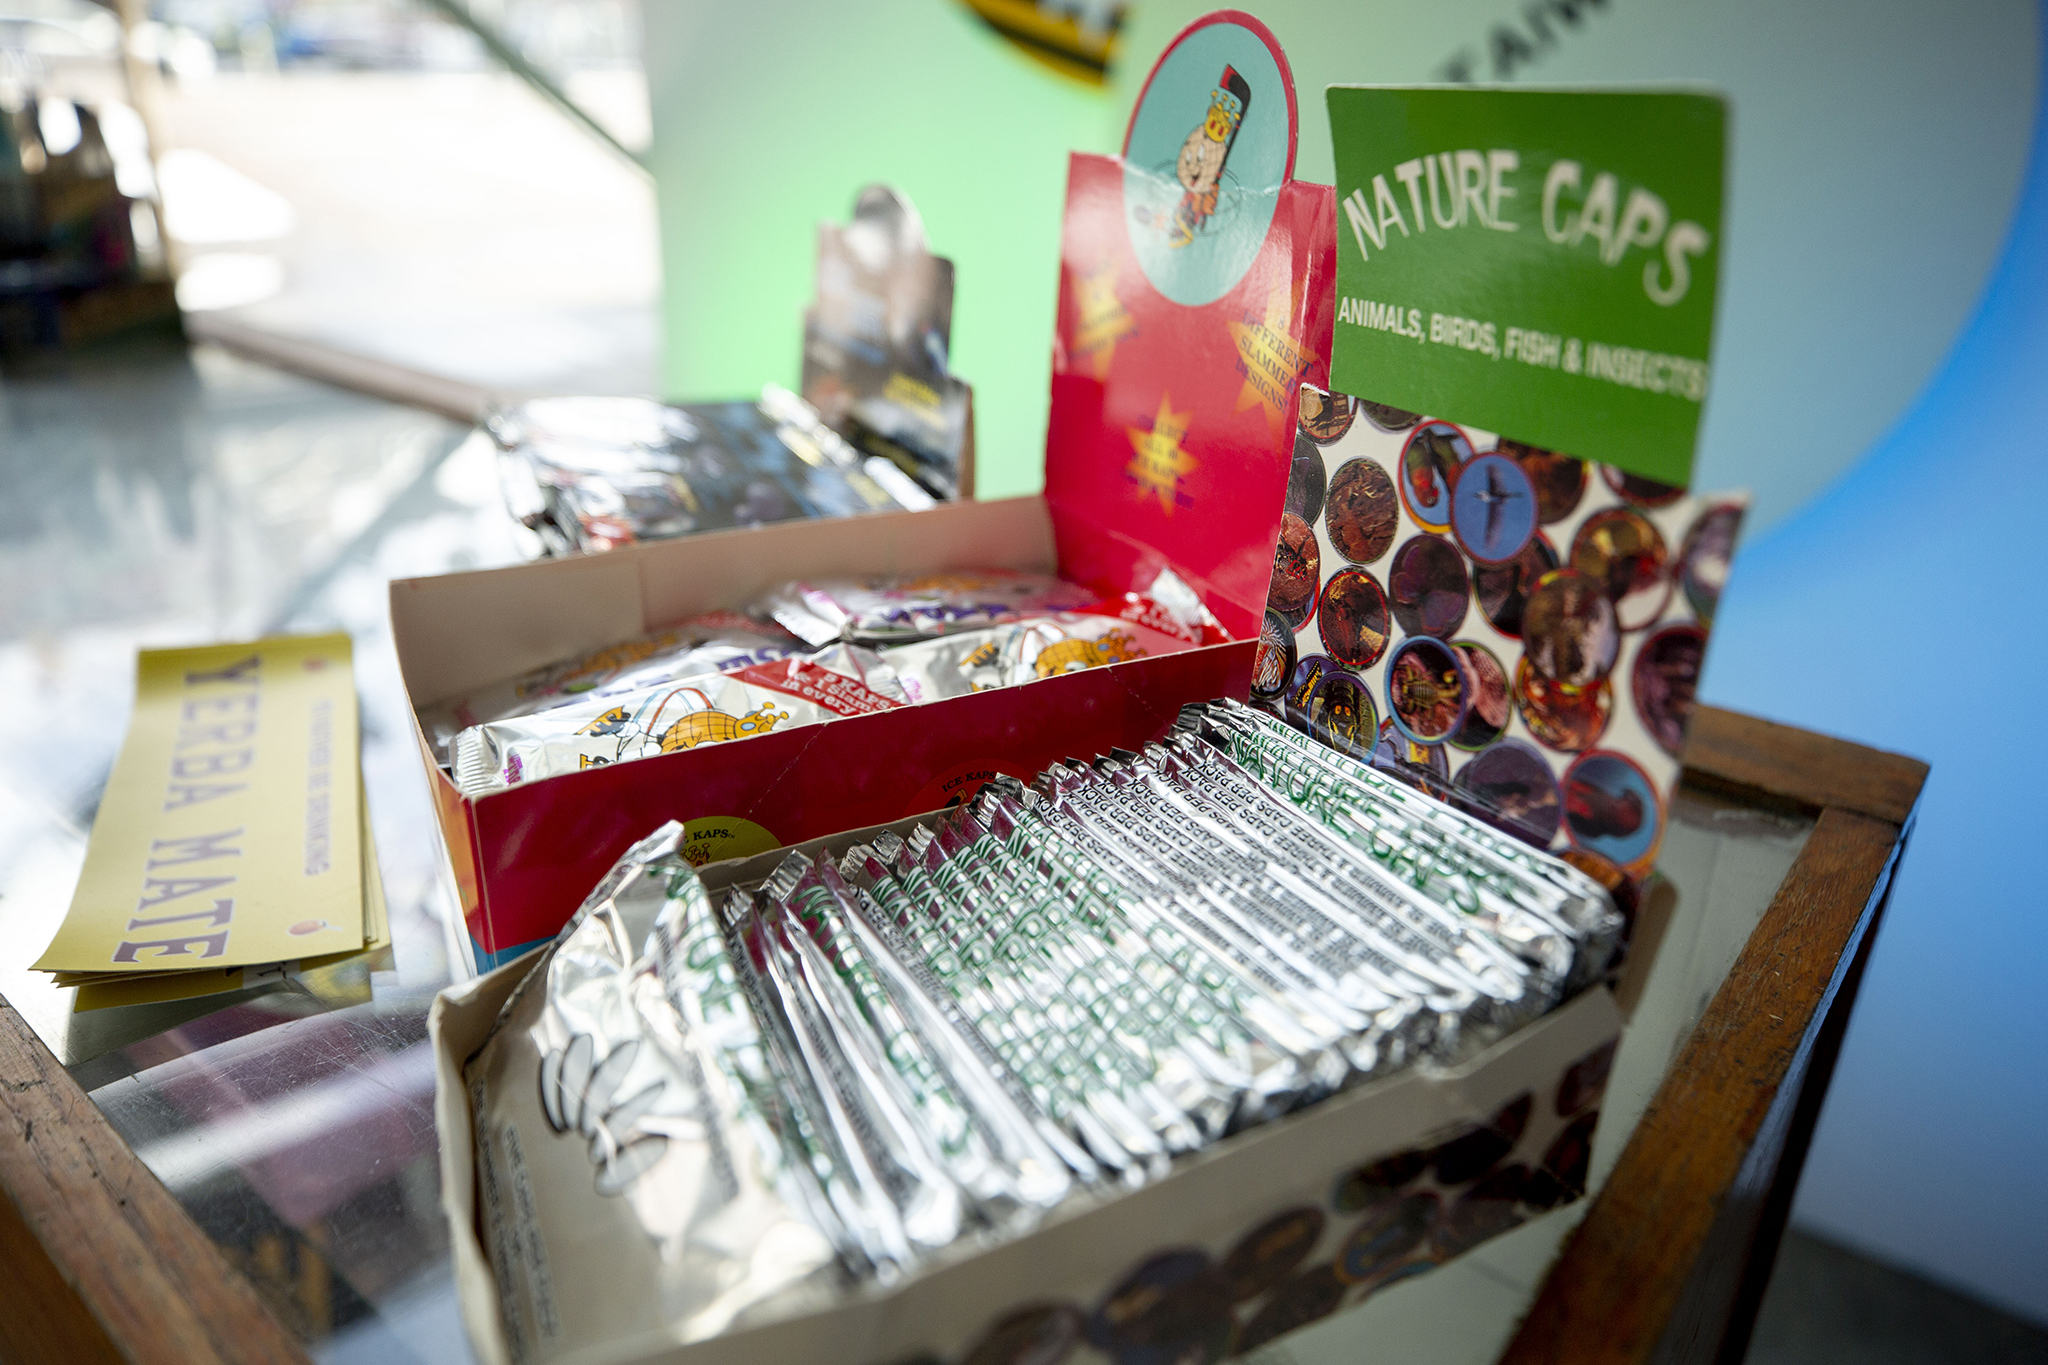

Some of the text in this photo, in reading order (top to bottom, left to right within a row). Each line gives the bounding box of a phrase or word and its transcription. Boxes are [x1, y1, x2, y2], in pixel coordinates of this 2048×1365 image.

[1342, 149, 1709, 307] NATURE CAPS
[1242, 310, 1313, 377] DIFFERENT
[1337, 296, 1425, 344] ANIMALS,
[1430, 313, 1501, 361] BIRDS,
[1504, 327, 1560, 368] FISH
[1561, 338, 1582, 374] &
[1240, 335, 1296, 394] SLAMMER
[1235, 356, 1288, 414] DESIGNS!
[794, 671, 811, 683] &
[823, 673, 838, 683] 5
[840, 677, 890, 710] KAPS
[780, 679, 857, 714] in every
[942, 770, 996, 793] ICE KAPS
[1149, 767, 1185, 795] PACK
[1180, 764, 1217, 794] PACK
[1196, 758, 1233, 789] PACK
[1077, 782, 1113, 812] PACK
[1096, 777, 1132, 806] PACK
[1125, 775, 1163, 807] PACK
[1182, 792, 1210, 815] PER
[1213, 787, 1242, 813] PER
[1229, 782, 1258, 806] PER
[111, 652, 262, 963] YERBA MATE
[1033, 795, 1065, 824] PACK
[1109, 805, 1137, 831] PER
[1128, 799, 1157, 823] PER
[1159, 800, 1188, 825] PER
[1238, 806, 1275, 838] CAPS
[1255, 798, 1292, 830] CAPS
[1062, 819, 1088, 842] PER
[1134, 824, 1172, 855] CAPS
[1155, 817, 1192, 848] CAPS
[1184, 819, 1223, 851] CAPS
[1290, 823, 1336, 860] THREE
[1086, 838, 1123, 869] CAPS
[1272, 833, 1319, 871] THREE
[1169, 849, 1216, 887] THREE
[999, 822, 1131, 948] NATURE
[897, 863, 1008, 991] NATURE
[928, 857, 1047, 987] NATURE
